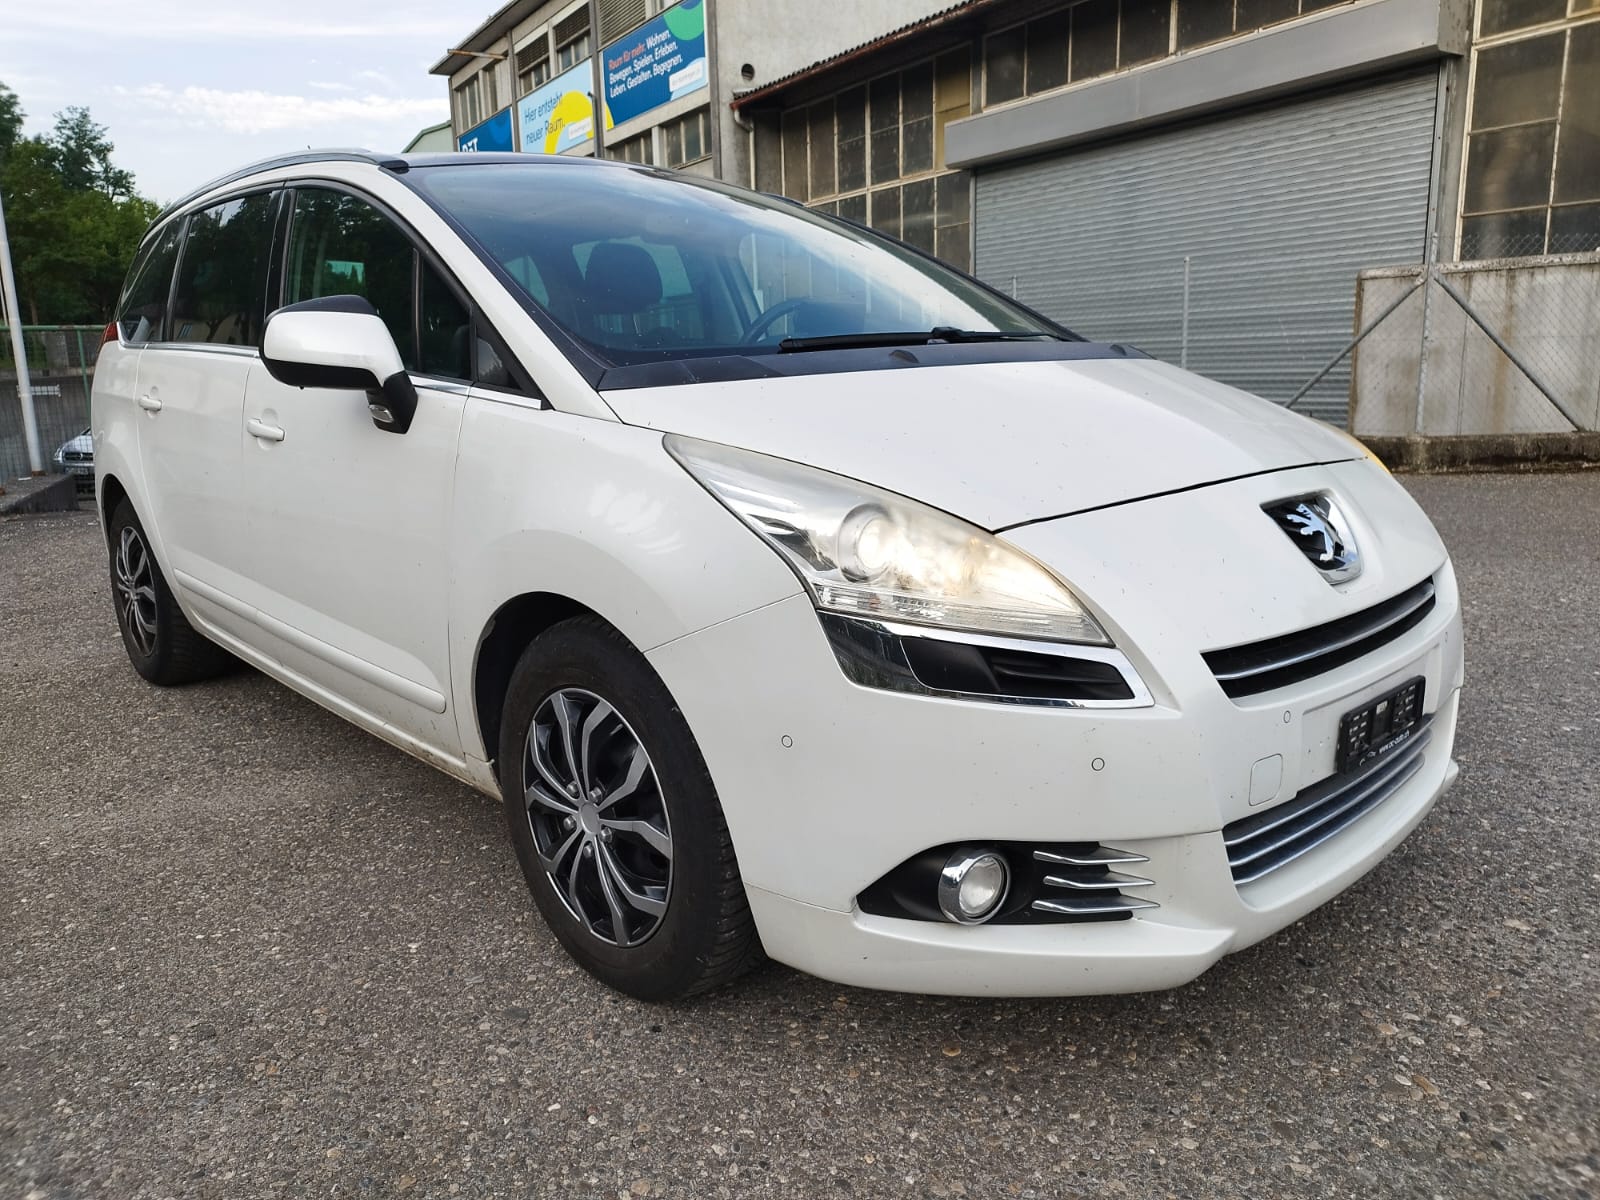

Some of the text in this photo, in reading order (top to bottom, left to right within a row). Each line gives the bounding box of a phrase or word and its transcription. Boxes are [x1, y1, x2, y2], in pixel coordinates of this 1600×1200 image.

[646, 30, 671, 49] Wohnen.
[609, 41, 678, 85] Bewegen. Spielen. Erleben.
[610, 84, 627, 98] Leben.
[627, 70, 652, 89] Gestalten.
[653, 54, 683, 76] Begegnen.
[524, 92, 563, 125] Hier entsteht
[526, 127, 544, 145] neuer
[544, 118, 566, 137] Raum.
